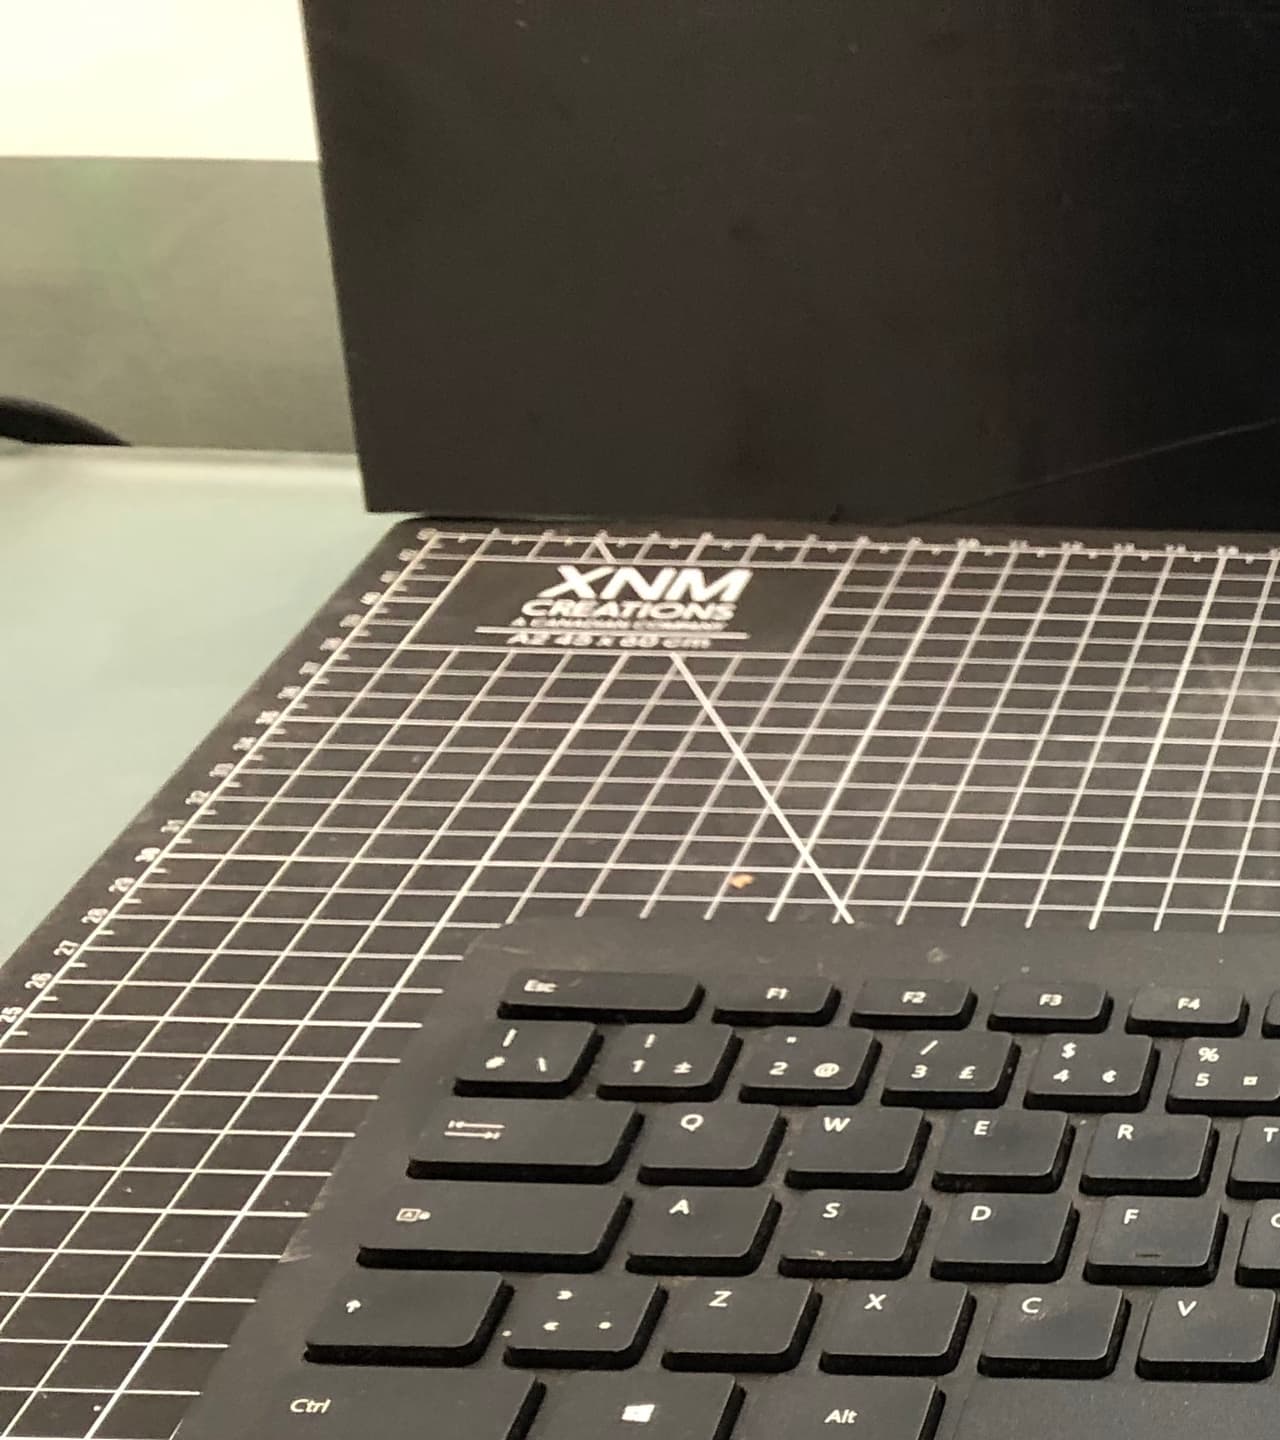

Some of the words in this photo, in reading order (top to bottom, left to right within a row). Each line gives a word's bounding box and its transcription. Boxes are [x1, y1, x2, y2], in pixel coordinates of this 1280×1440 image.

[539, 565, 754, 602] XNM
[522, 599, 738, 621] CREATIONS
[54, 940, 79, 956] 27
[524, 980, 556, 992] Esc
[766, 988, 788, 999] F1
[902, 991, 926, 1003] F2
[1040, 994, 1062, 1006] F3
[1178, 997, 1200, 1010] F4
[1062, 1042, 1076, 1059] $
[1198, 1047, 1219, 1062] %
[633, 1059, 645, 1073] 1
[769, 1062, 788, 1075] 2
[814, 1063, 840, 1077] @
[911, 1065, 928, 1078] 3
[1053, 1069, 1069, 1082] 4
[1195, 1073, 1210, 1087] 5
[680, 1114, 704, 1131] Q
[824, 1117, 851, 1132] W
[974, 1120, 990, 1135] E
[1117, 1124, 1134, 1140] R
[1264, 1127, 1279, 1142] T
[669, 1199, 689, 1214] A
[823, 1203, 840, 1218] S
[971, 1206, 991, 1221] D
[1124, 1209, 1139, 1224] F
[709, 1291, 732, 1307] Z
[864, 1294, 886, 1310] X
[1022, 1297, 1042, 1314] C
[1178, 1301, 1197, 1316] V
[290, 1399, 331, 1413] Ctrl
[824, 1409, 857, 1423] Alt
